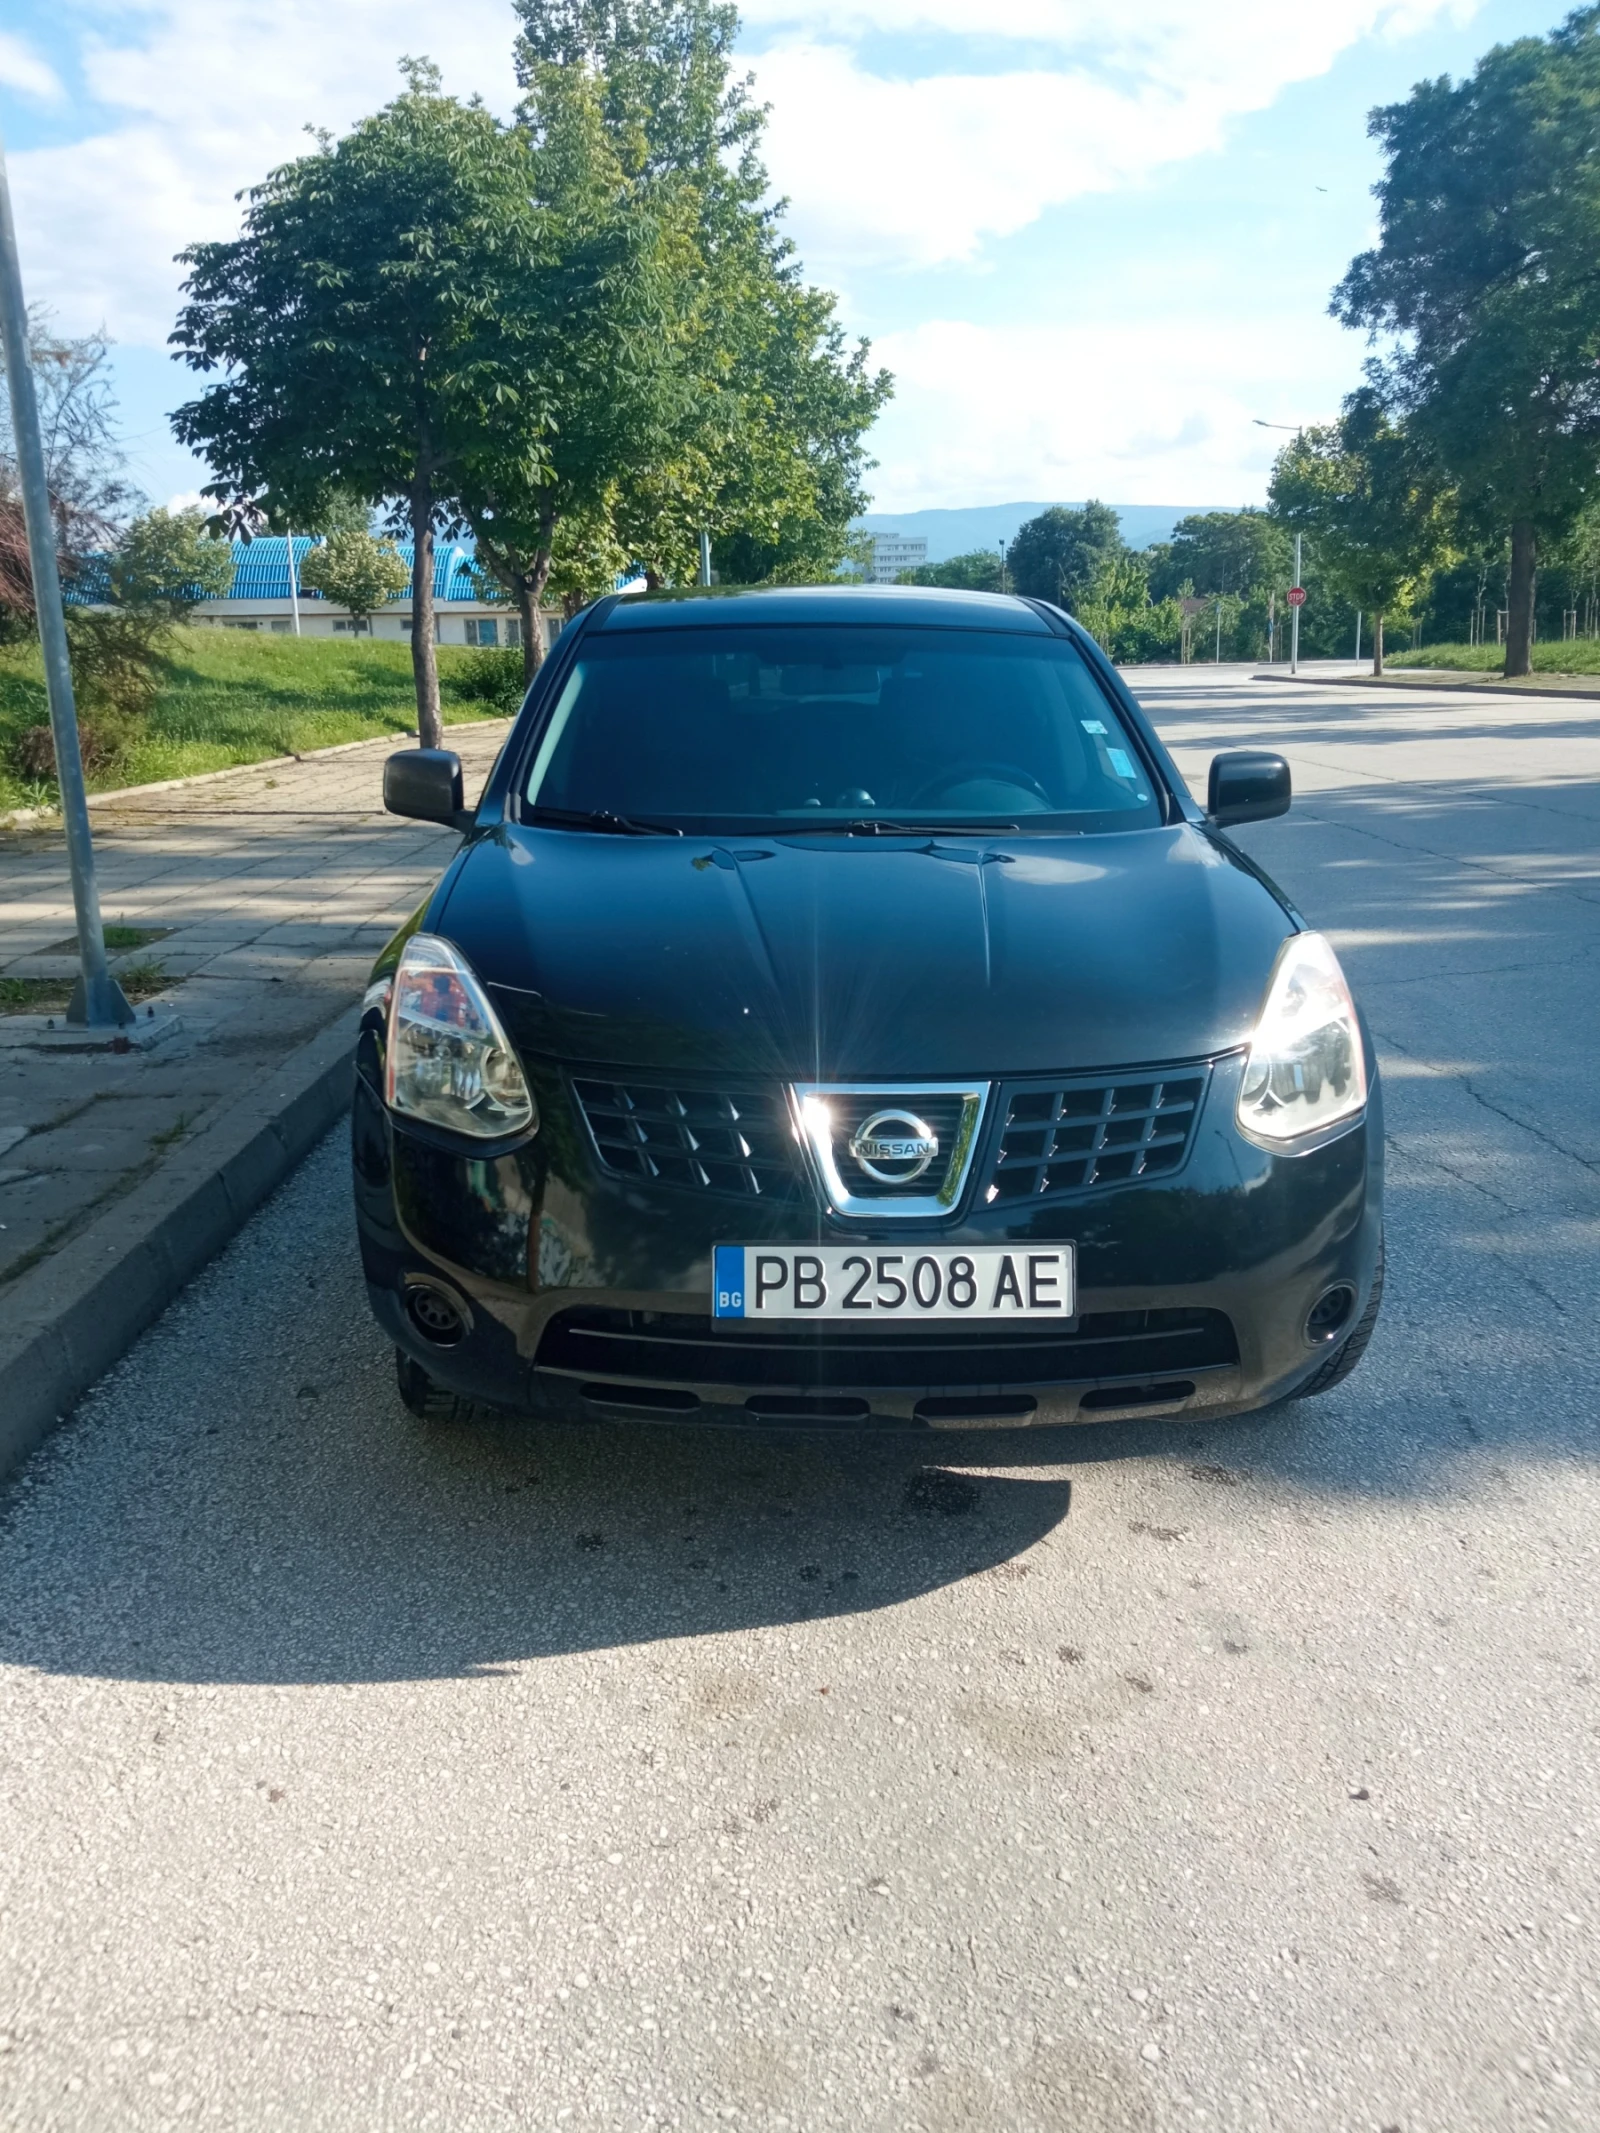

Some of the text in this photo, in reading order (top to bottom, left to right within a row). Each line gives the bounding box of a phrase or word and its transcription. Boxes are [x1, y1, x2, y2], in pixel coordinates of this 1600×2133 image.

[1289, 593, 1304, 601] STOP
[858, 1142, 930, 1155] NISSAN
[755, 1254, 1062, 1309] PB 2508 AE
[719, 1292, 742, 1308] BG
